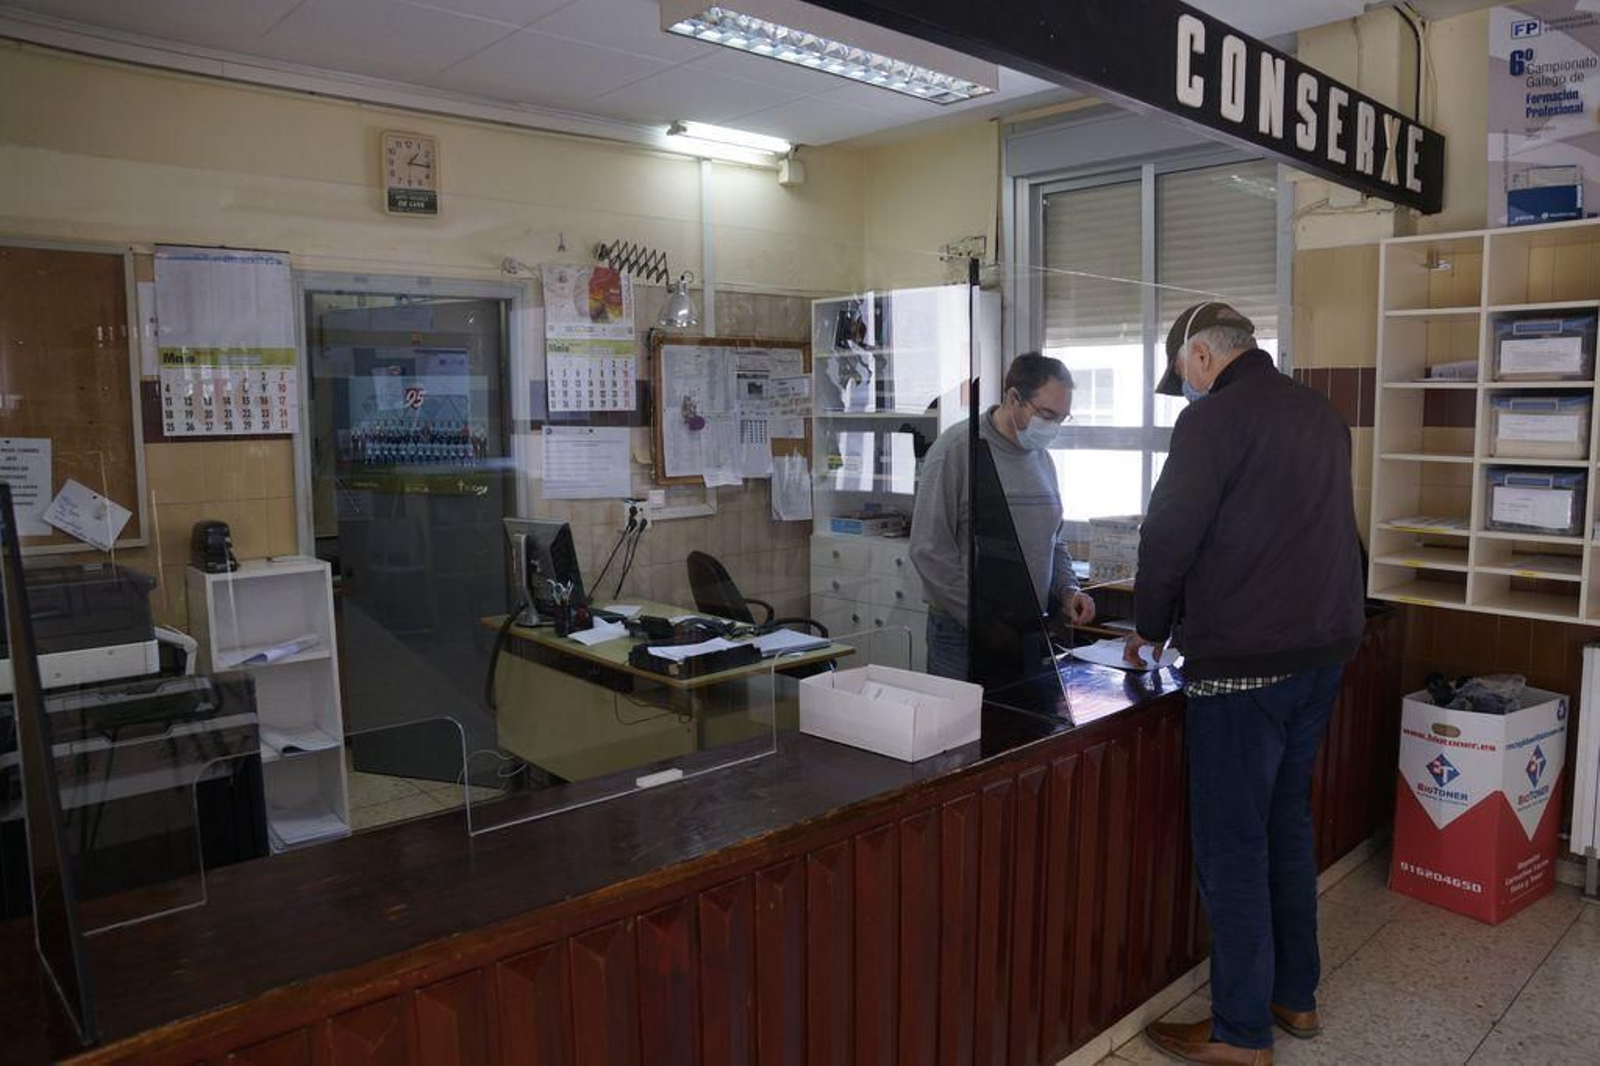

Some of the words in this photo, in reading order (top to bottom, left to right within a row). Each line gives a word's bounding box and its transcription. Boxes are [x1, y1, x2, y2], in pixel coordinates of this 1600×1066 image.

[1514, 22, 1537, 36] FP
[1526, 58, 1597, 75] Campionato
[1526, 75, 1566, 88] Galego
[1569, 73, 1584, 83] de
[1176, 13, 1424, 193] CONSERXE
[1526, 89, 1579, 104] Formación
[1525, 102, 1583, 118] Profesional
